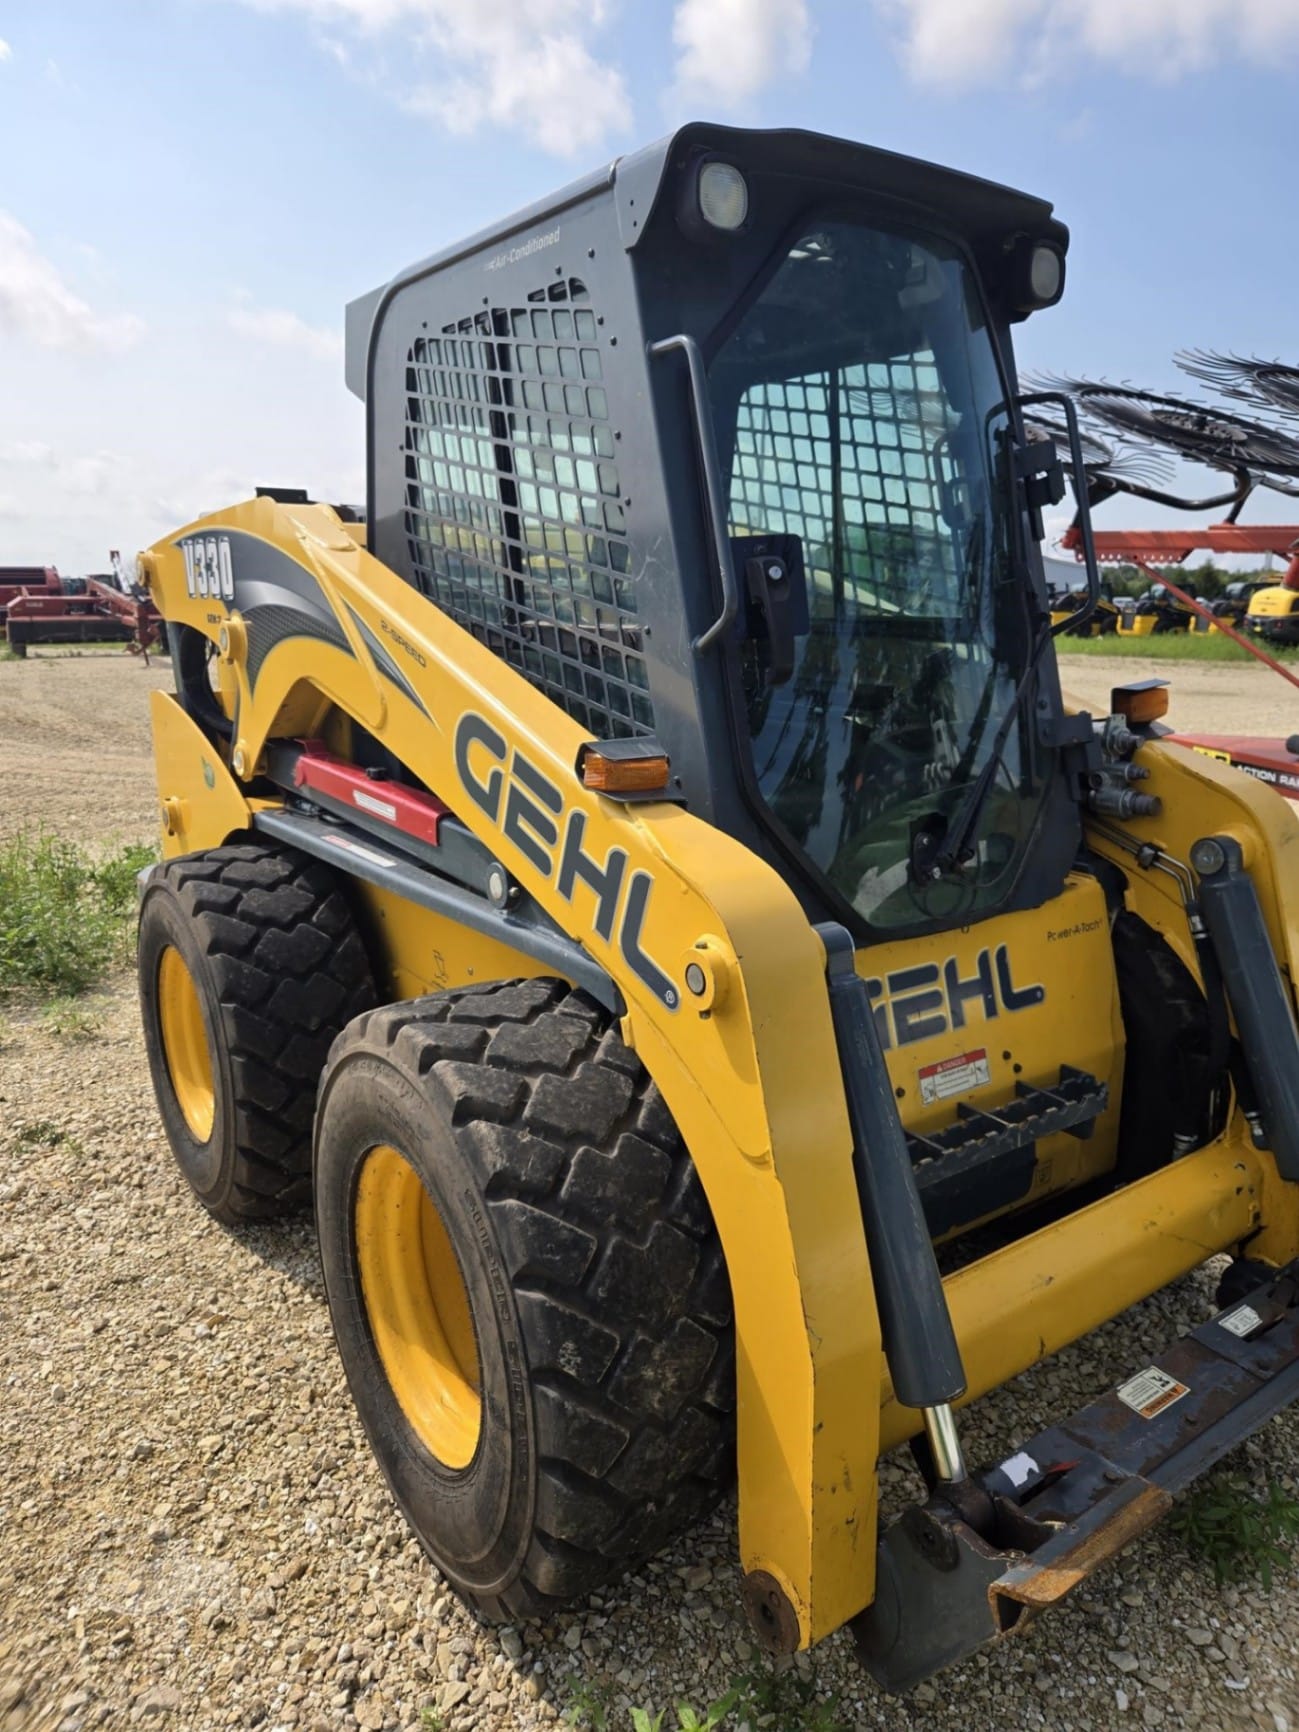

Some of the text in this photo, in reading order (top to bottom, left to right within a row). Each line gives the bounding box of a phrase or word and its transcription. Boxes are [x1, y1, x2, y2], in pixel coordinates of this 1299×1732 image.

[181, 535, 235, 601] V330
[1279, 773, 1299, 788] RA
[455, 711, 679, 1013] GEHL
